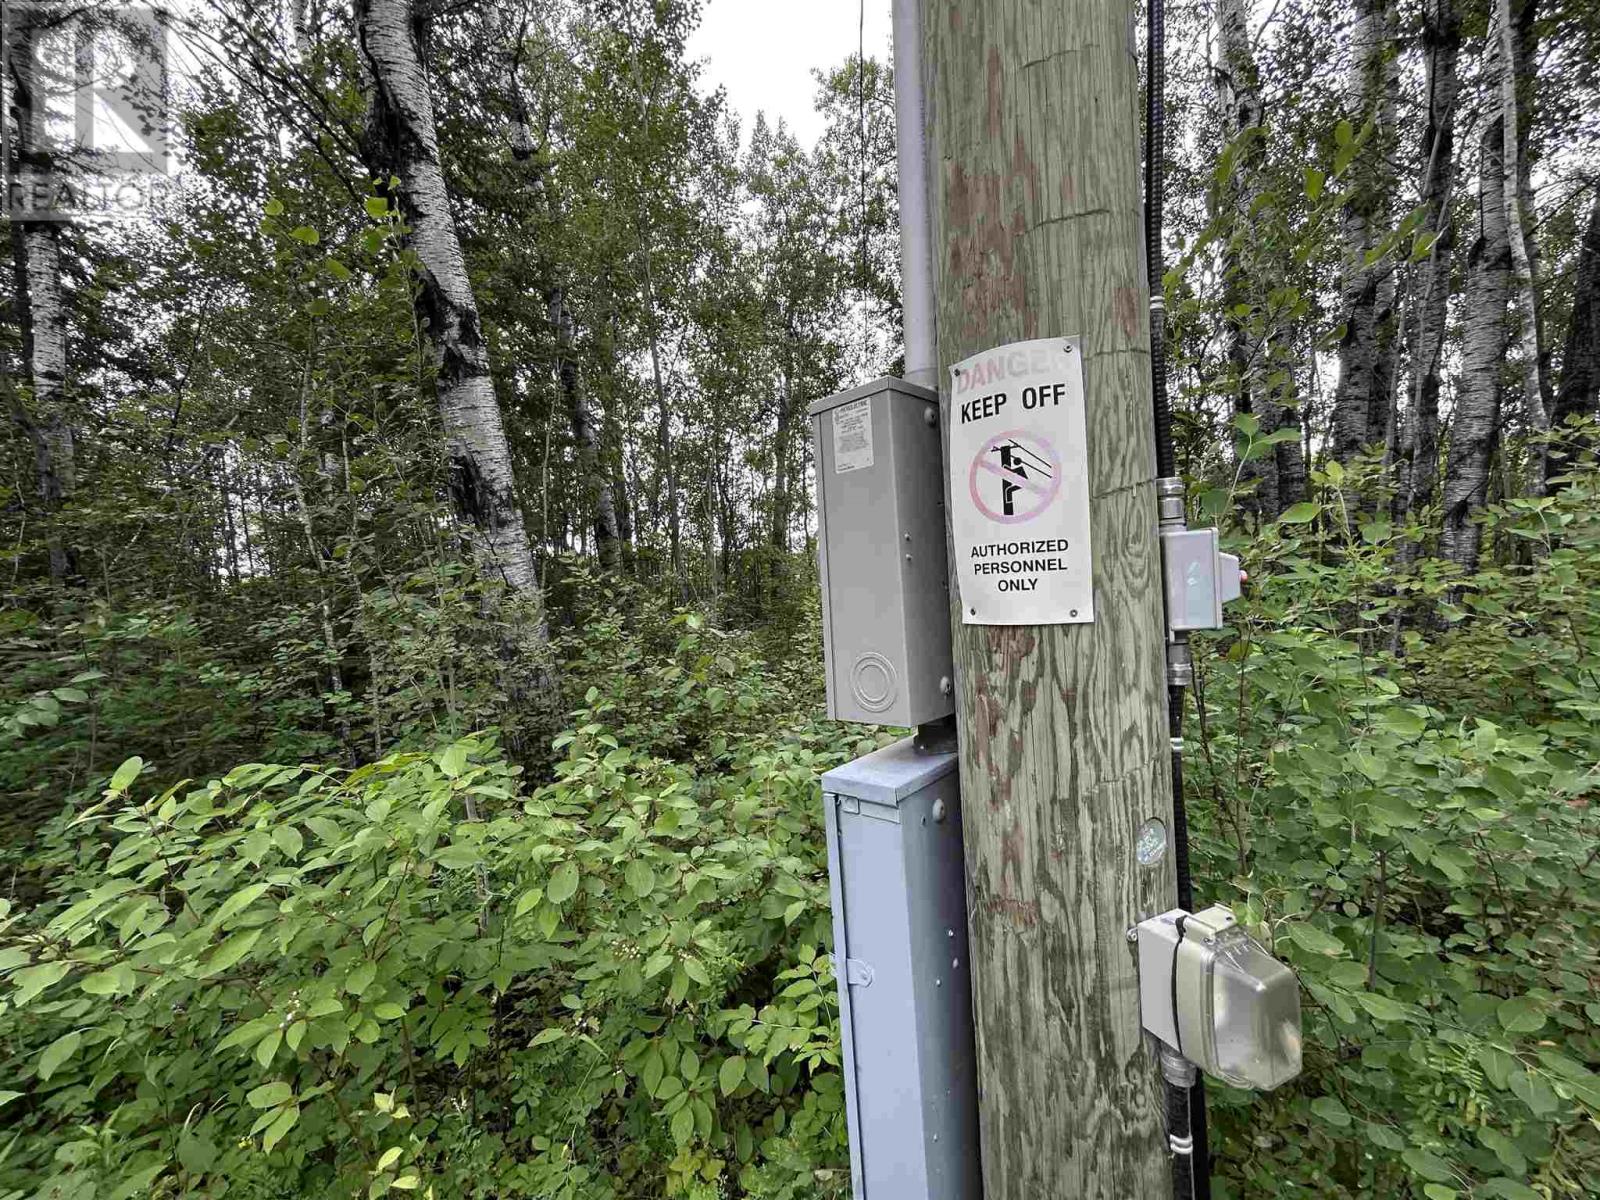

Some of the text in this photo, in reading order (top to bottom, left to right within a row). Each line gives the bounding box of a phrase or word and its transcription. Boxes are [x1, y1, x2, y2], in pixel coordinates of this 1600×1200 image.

[957, 348, 1070, 394] DANGE
[960, 383, 1066, 425] KEEP OFF
[970, 539, 1069, 558] AUTHORIZED
[973, 557, 1068, 575] PERSONNEL
[997, 577, 1038, 592] ONLY
